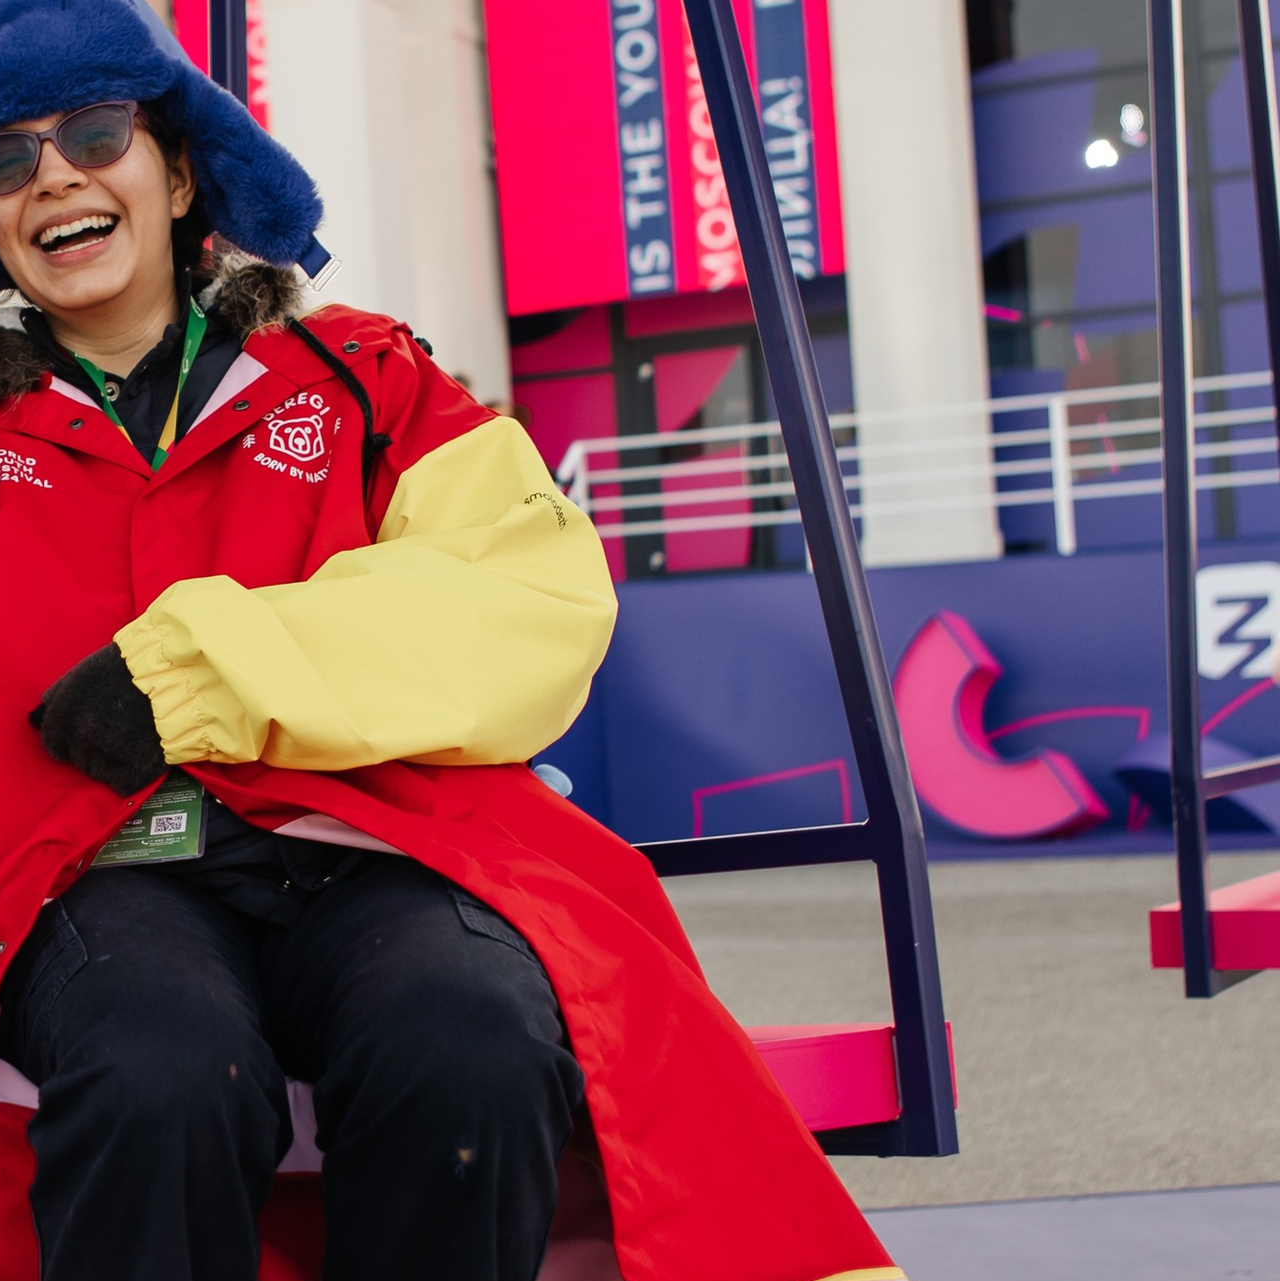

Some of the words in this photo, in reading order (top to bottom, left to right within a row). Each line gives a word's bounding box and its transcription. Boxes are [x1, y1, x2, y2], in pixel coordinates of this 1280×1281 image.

[622, 116, 666, 230] THE
[631, 239, 673, 294] IS
[254, 453, 287, 472] BORN
[289, 466, 304, 480] BY
[306, 467, 329, 483] NAT
